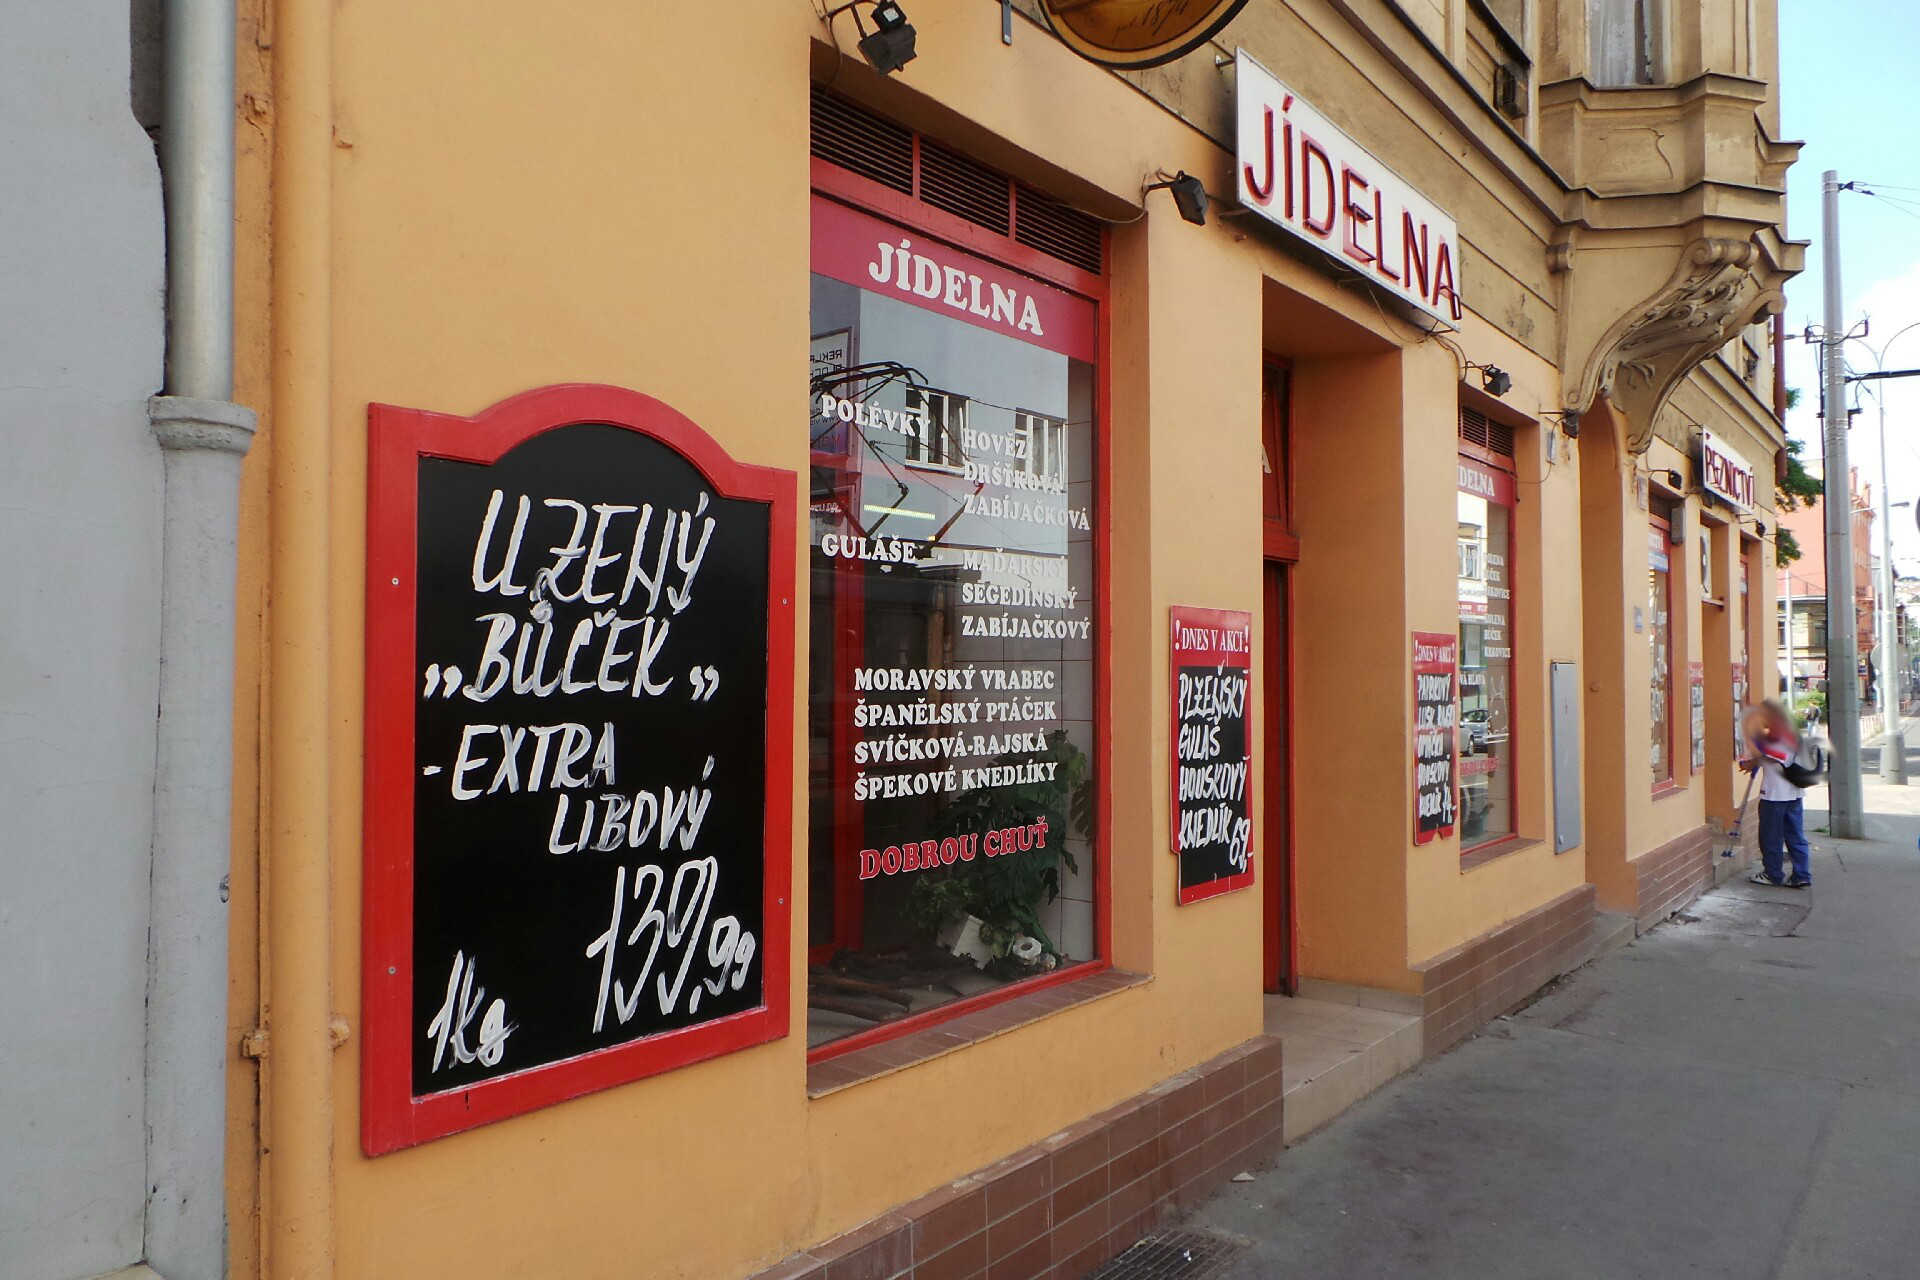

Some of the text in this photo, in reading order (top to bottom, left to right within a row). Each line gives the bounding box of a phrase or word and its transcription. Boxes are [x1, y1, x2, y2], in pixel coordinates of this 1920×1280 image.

[1243, 92, 1463, 321] JÍDELNA
[868, 239, 1044, 336] JÍDELNA
[821, 394, 931, 439] POLÉVKY
[1704, 432, 1755, 510] ŘEZNICTVÍ
[963, 493, 1091, 531] ZABÍJAČKOVÁ
[472, 489, 716, 615] UZENÝ
[821, 532, 916, 563] GULÁŠE
[962, 547, 1067, 578] MAĎARSKÝ
[962, 582, 1078, 609] SEGEDÍNSKÝ
[961, 612, 1091, 640] ZABÍJAČKOVÝ
[1210, 629, 1219, 651] V
[854, 664, 1055, 691] MORAVSKÝ VRABEC
[854, 696, 1056, 728] ŠPANĚLSKÝ PTÁČEK
[854, 727, 1049, 765] SVÍČKOVÁ-RAJSKÁ
[854, 758, 1058, 801] ŠPEKOVÉ KNEDLÍKY
[1178, 754, 1251, 802] HOUSKOVÝ
[548, 754, 716, 855] LIBOVÝ
[859, 815, 1049, 881] DOBROU CHUŤ
